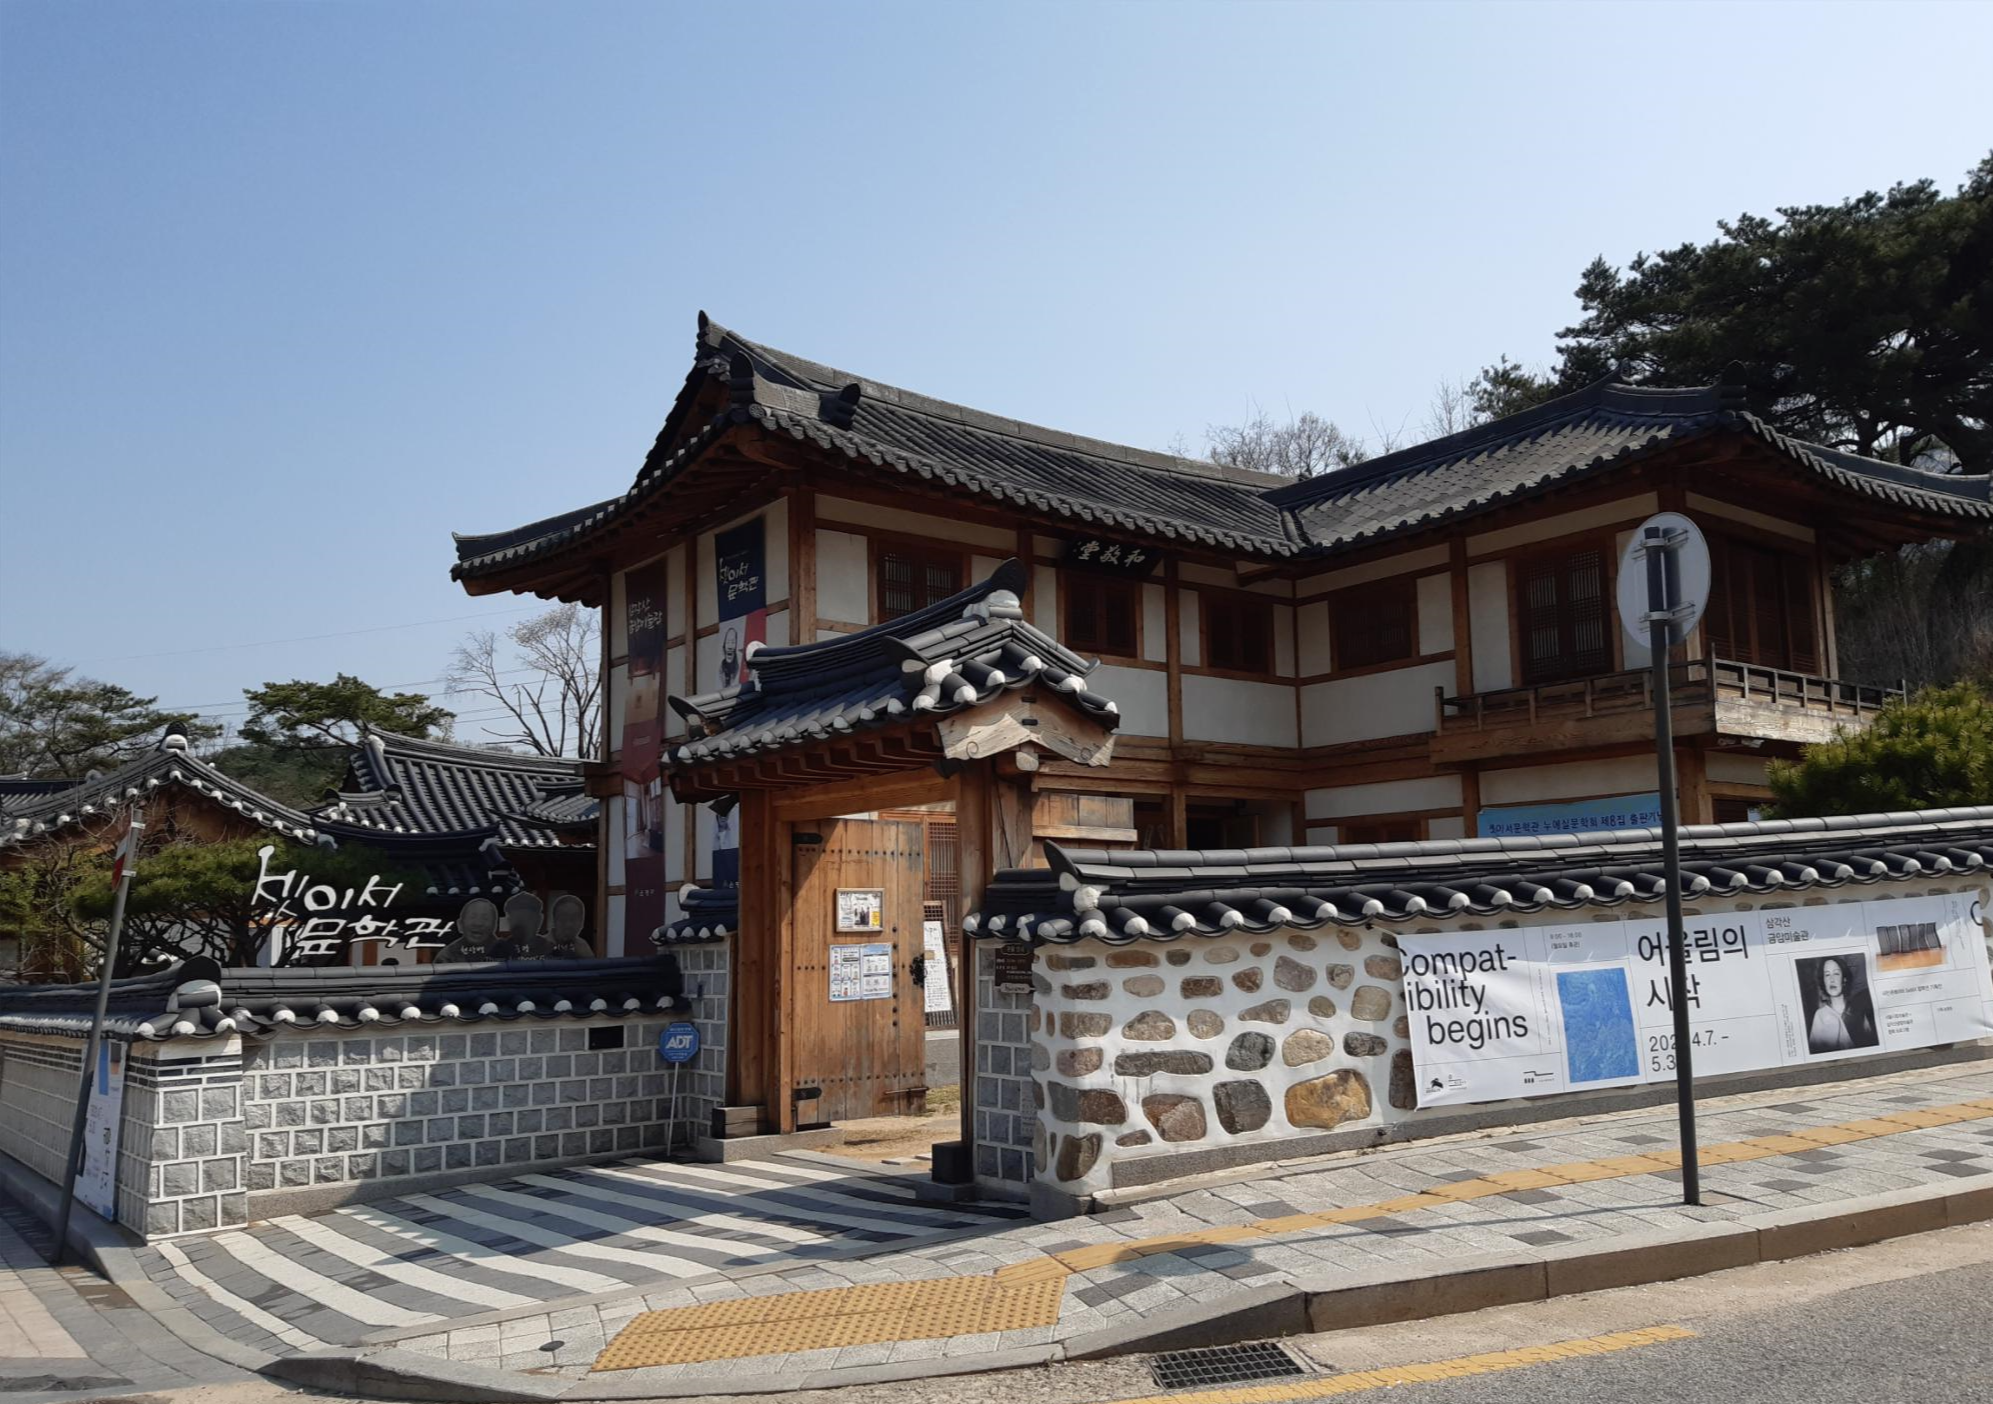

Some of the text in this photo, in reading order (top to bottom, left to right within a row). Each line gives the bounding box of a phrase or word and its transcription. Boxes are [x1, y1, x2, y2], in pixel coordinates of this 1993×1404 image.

[719, 557, 750, 585] 셋이서
[727, 576, 759, 601] 문학관
[1601, 814, 1626, 828] 제8집
[251, 844, 404, 919] 셋이서
[296, 914, 456, 956] 문학관
[1766, 915, 1791, 929] 삼각산
[1406, 978, 1486, 1015] ibility
[665, 1035, 694, 1049] ADT
[1426, 1010, 1529, 1050] begins
